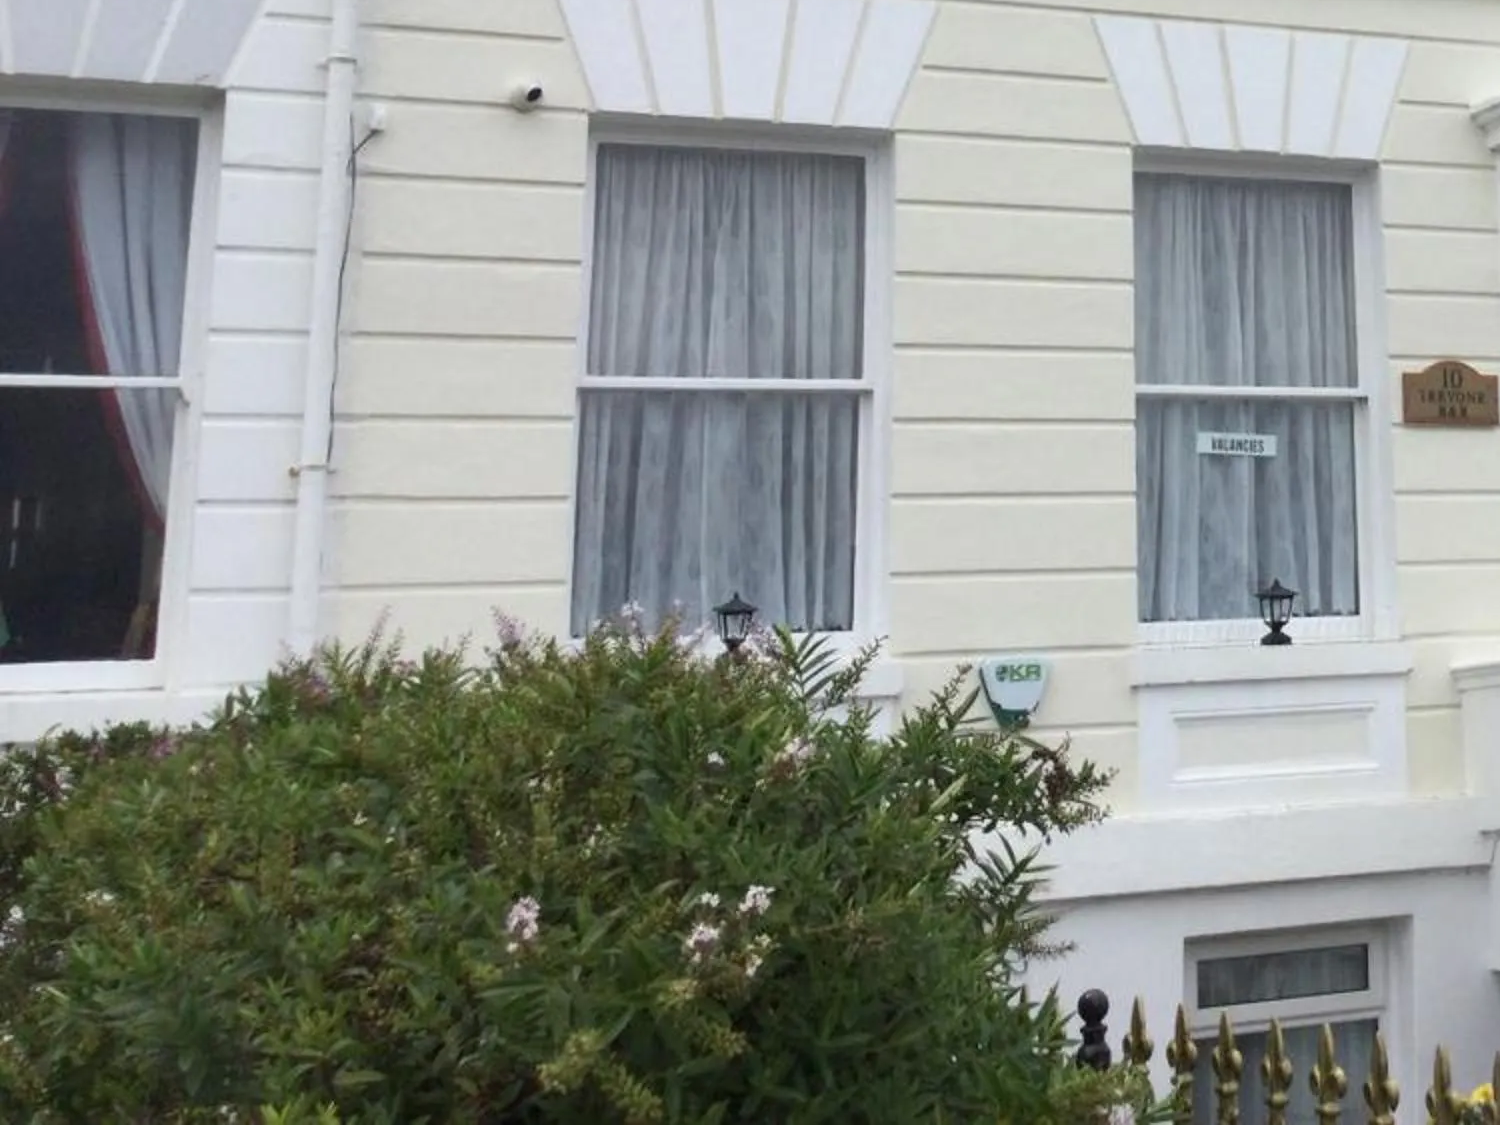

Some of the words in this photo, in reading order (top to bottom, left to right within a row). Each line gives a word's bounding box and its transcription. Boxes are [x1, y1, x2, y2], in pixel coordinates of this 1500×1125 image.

[1443, 367, 1463, 388] 10
[1418, 388, 1485, 404] TREVONE
[1211, 438, 1265, 453] VACANCIES
